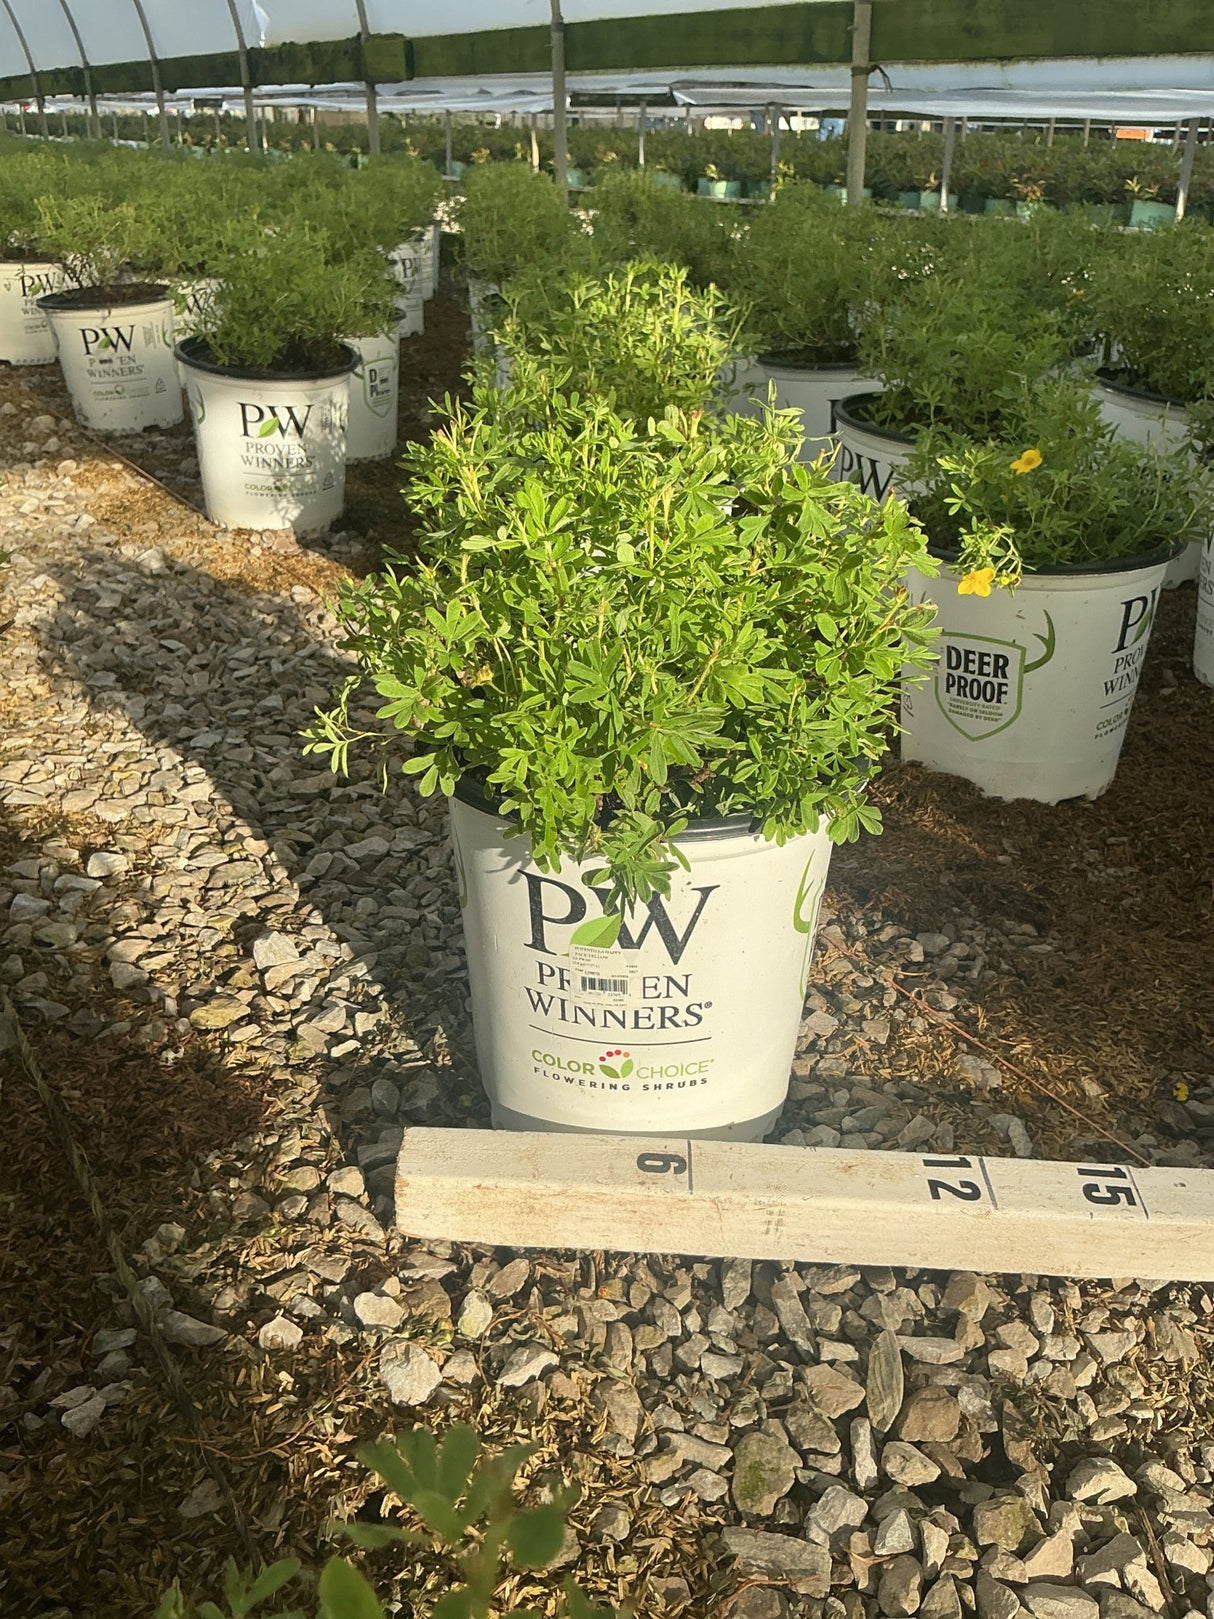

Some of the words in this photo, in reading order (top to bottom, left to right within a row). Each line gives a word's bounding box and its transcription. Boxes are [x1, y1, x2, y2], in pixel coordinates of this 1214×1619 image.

[78, 325, 135, 355] PW
[237, 402, 315, 439] PW
[246, 441, 309, 456] PROVEN
[946, 645, 1009, 680] DEER
[517, 868, 720, 966] PW
[536, 961, 692, 1000] PREN
[531, 1049, 595, 1076] COLOR
[534, 1066, 630, 1091] FLOWERING
[642, 1078, 708, 1091] SHRUBS
[636, 1152, 687, 1174] 6
[922, 1157, 982, 1201] 12
[1076, 1167, 1137, 1206] 15
